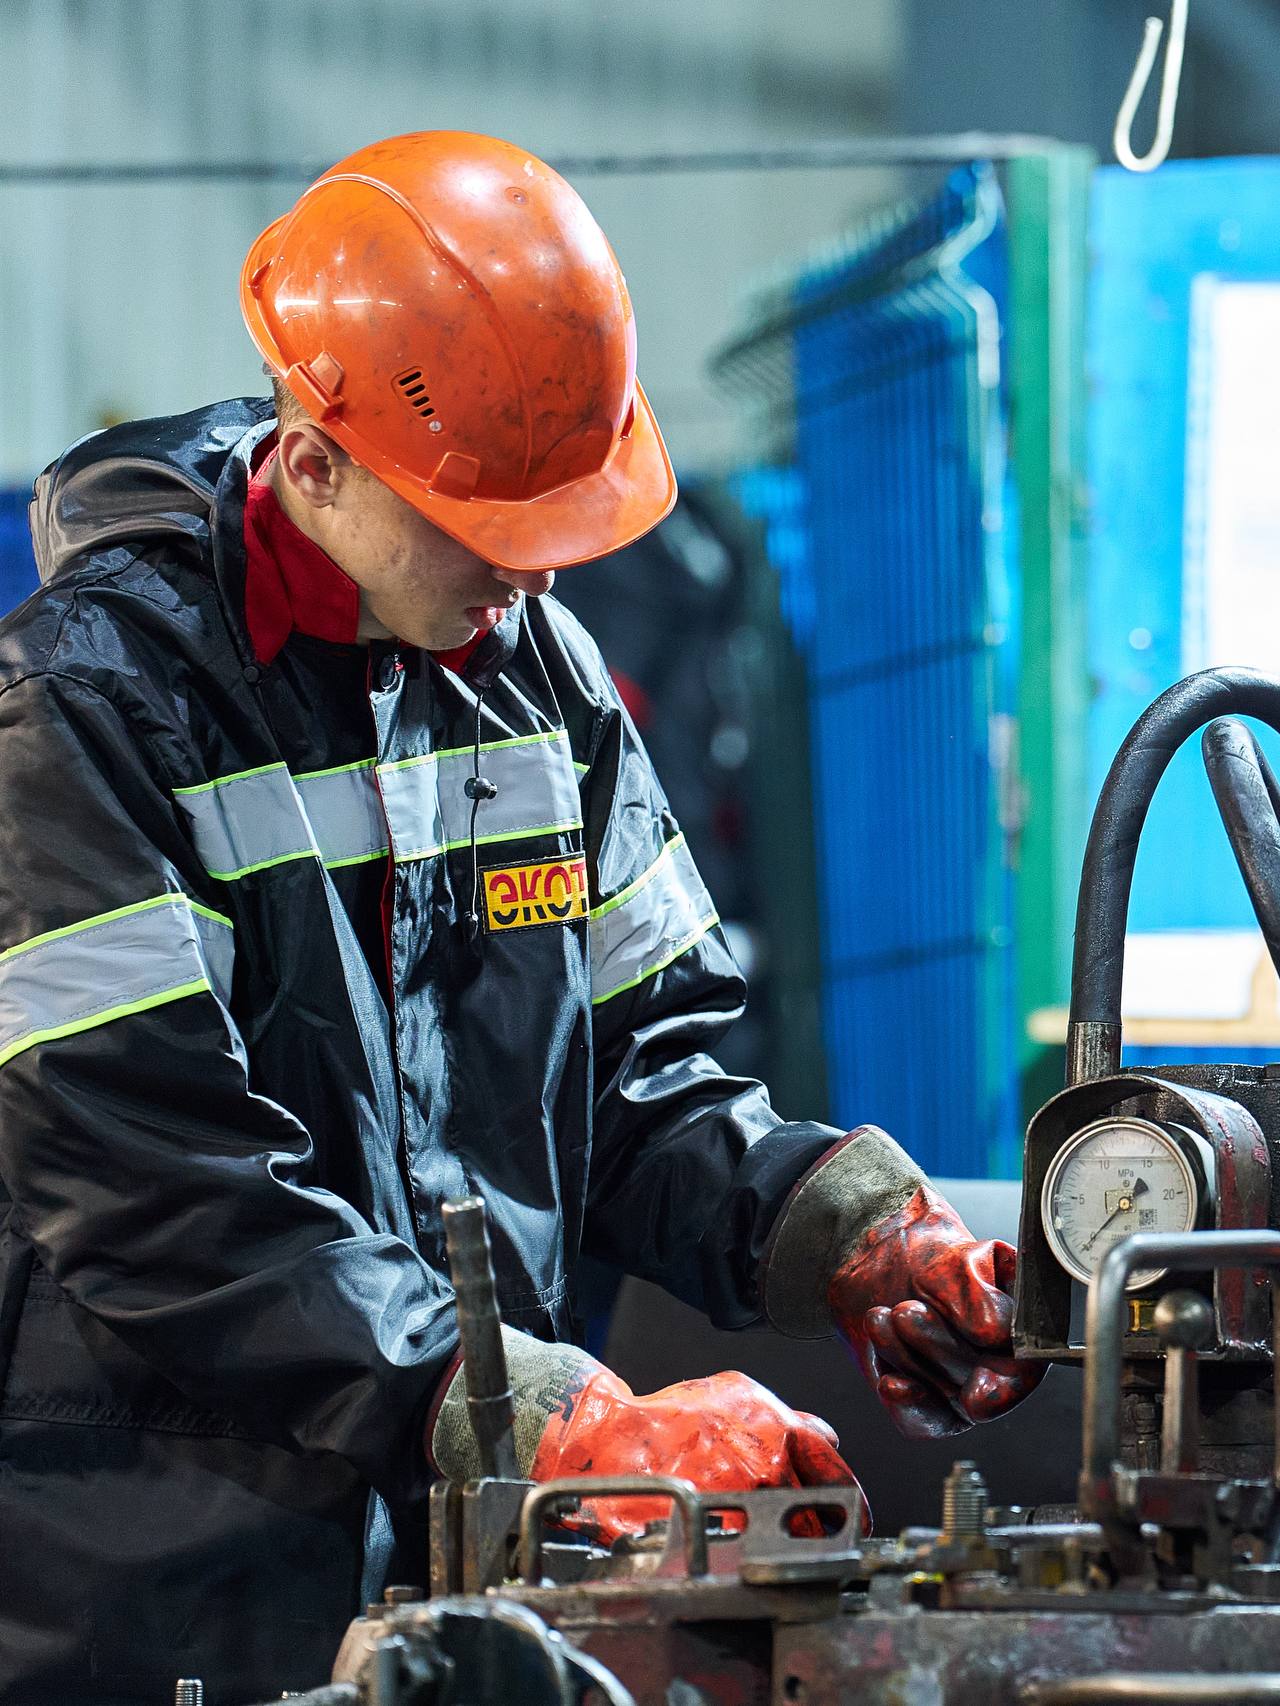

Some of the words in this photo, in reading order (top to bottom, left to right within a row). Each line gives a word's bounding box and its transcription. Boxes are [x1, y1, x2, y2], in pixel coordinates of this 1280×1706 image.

[1099, 1159, 1110, 1169] 10
[1142, 1159, 1153, 1168] 15
[1117, 1168, 1135, 1178] MPa
[1079, 1194, 1085, 1205] 5
[1162, 1188, 1175, 1201] 20
